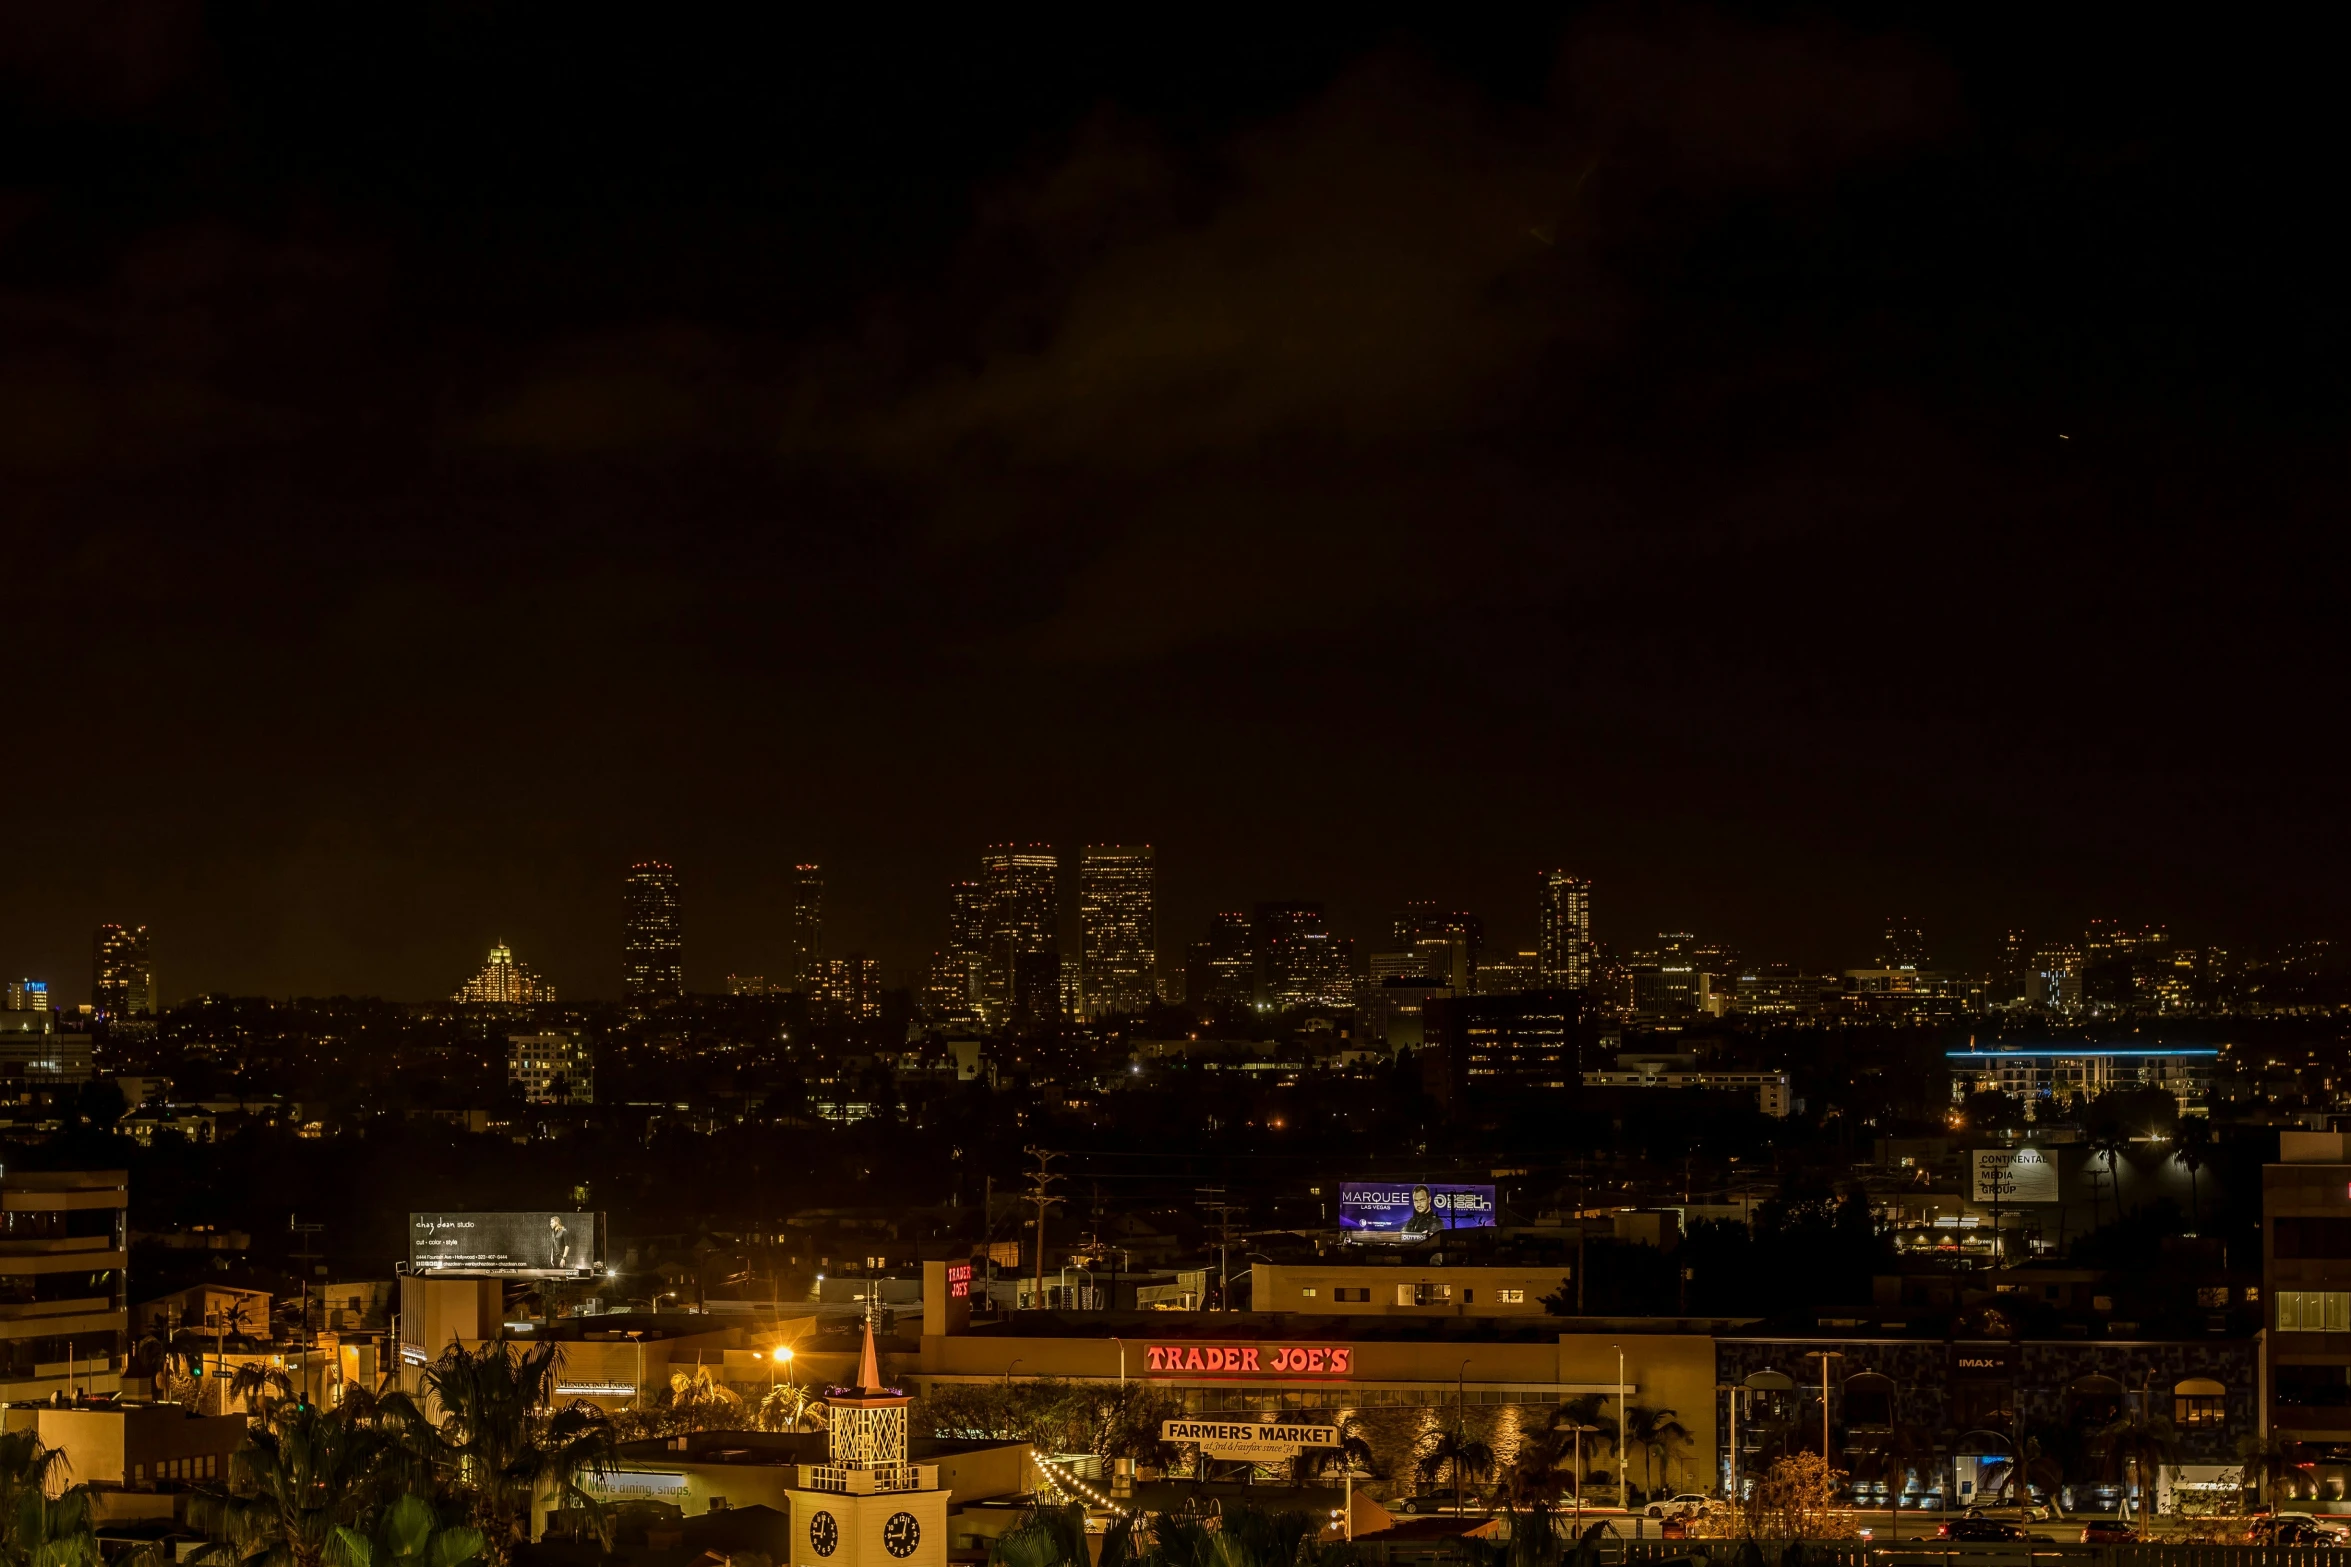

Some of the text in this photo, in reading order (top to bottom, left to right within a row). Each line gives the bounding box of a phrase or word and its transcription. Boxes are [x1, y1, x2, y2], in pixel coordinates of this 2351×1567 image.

[1981, 1155, 2048, 1164] CONTINENTAL
[1981, 1171, 2013, 1179] MEDIA
[1342, 1191, 1409, 1204] MARQUEE
[1981, 1186, 2016, 1194] GROUP
[416, 1216, 434, 1235] chaz
[437, 1217, 455, 1228] dean
[948, 1265, 971, 1282] TRADER
[951, 1281, 968, 1298] JOE'S
[1148, 1347, 1350, 1373] TRADER JOE'S
[1958, 1359, 1994, 1367] IMAX
[1169, 1423, 1334, 1443] FARMERS MARKET
[1203, 1441, 1213, 1451] at
[1213, 1441, 1227, 1451] 3rd
[1233, 1442, 1261, 1455] Fairfax
[1262, 1443, 1282, 1453] since
[619, 1481, 655, 1497] dining,
[657, 1483, 692, 1498] shops,
